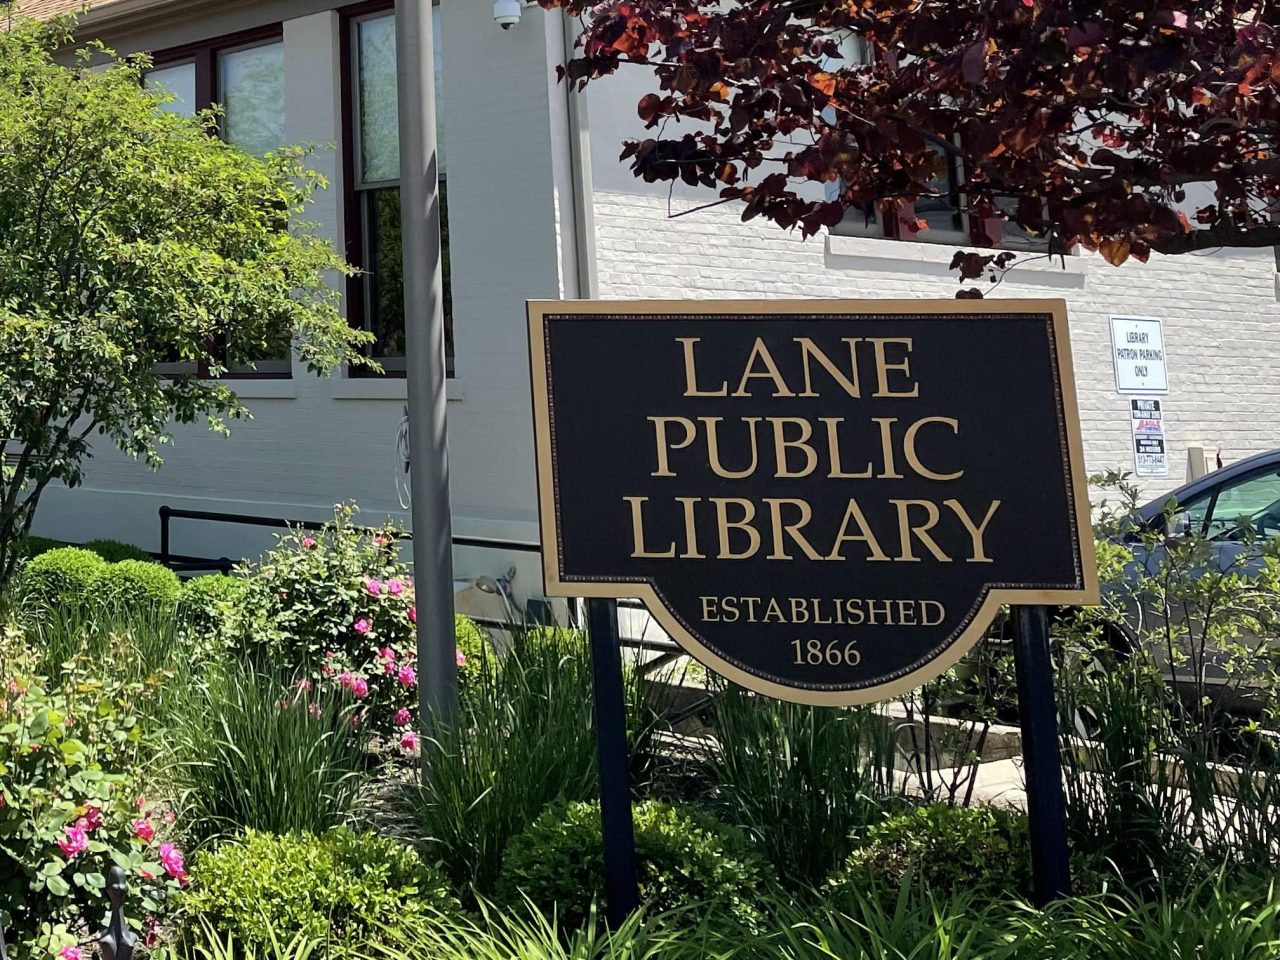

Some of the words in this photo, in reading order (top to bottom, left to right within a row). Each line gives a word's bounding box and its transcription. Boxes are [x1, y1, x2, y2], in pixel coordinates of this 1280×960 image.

[1126, 332, 1149, 344] LIBRARY
[674, 336, 920, 399] LANE
[1117, 348, 1138, 360] PATRON
[1139, 348, 1163, 361] PARKING
[1135, 365, 1148, 377] ONLY
[646, 415, 966, 480] PUBLIC
[623, 496, 1002, 564] LIBRARY
[699, 596, 946, 627] ESTABLISHED
[790, 639, 862, 667] 1866
